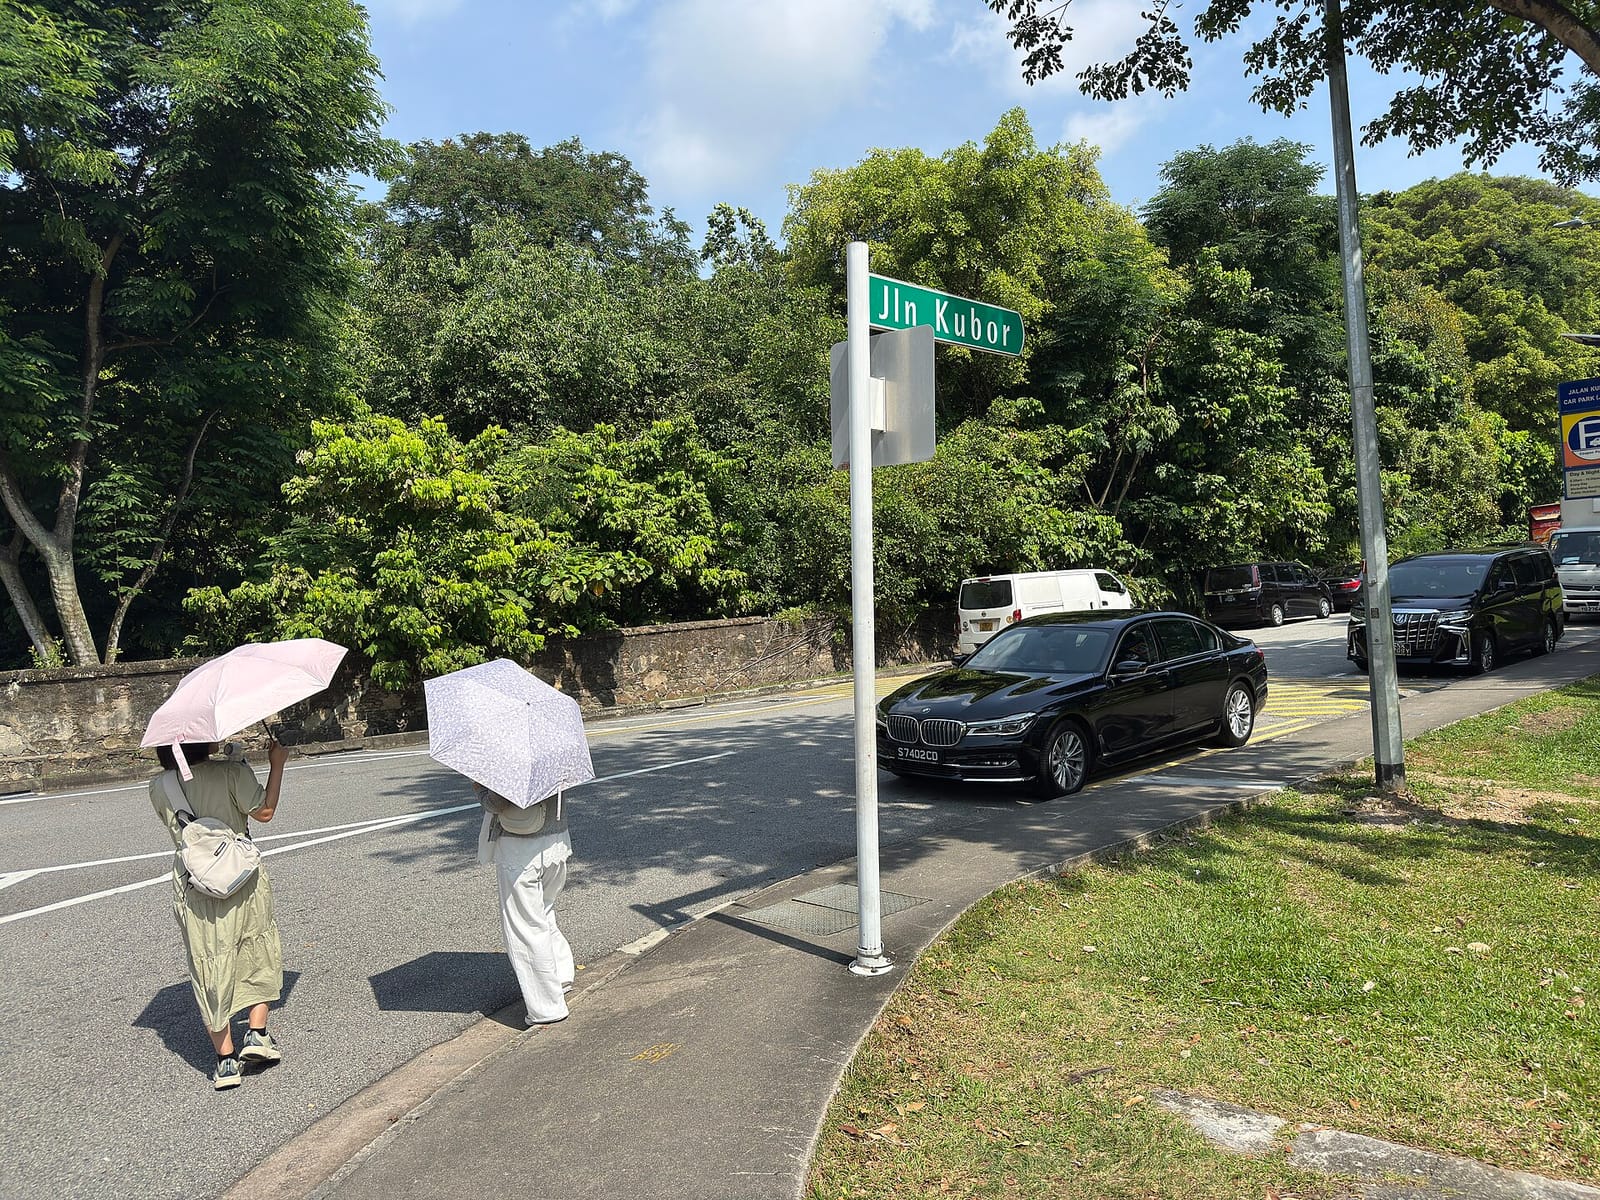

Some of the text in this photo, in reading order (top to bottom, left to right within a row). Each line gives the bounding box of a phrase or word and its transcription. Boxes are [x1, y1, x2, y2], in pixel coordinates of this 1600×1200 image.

[878, 285, 1011, 347] Jln Kubor
[1568, 386, 1589, 396] JALAN
[1578, 395, 1595, 403] PARK
[897, 747, 939, 761] S7402CD
